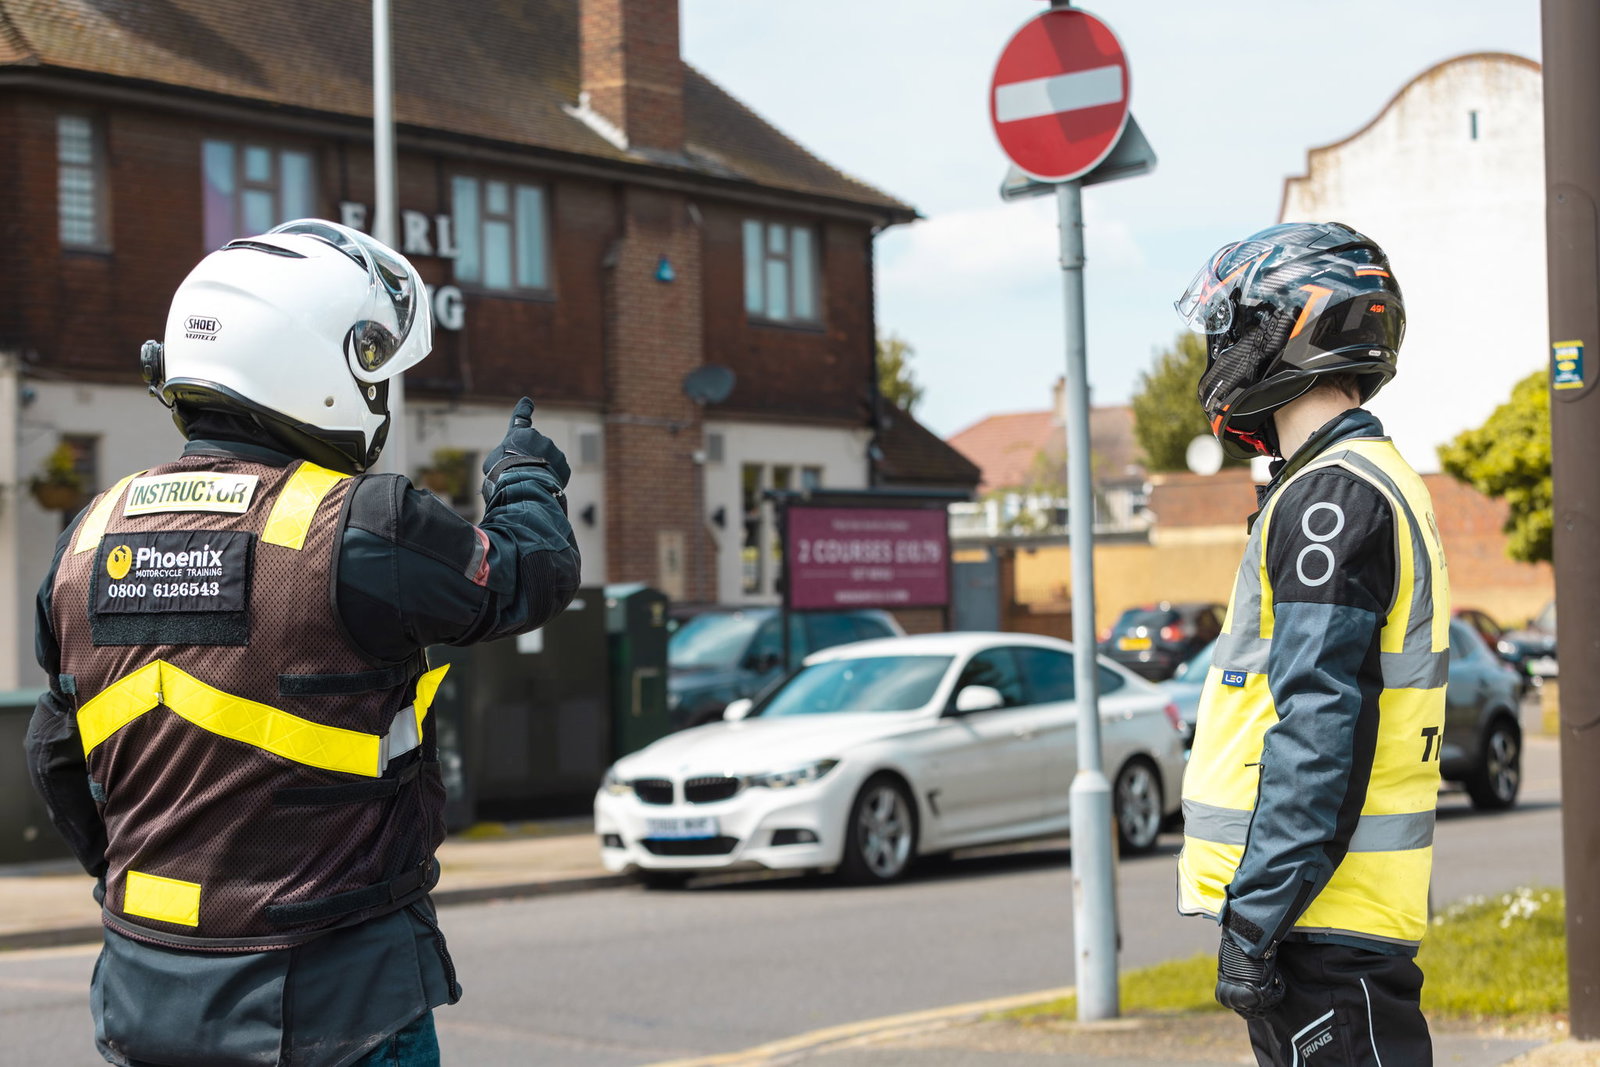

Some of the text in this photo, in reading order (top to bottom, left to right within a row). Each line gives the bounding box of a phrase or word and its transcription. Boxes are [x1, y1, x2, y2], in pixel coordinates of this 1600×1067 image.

[1370, 304, 1385, 313] 491
[188, 318, 216, 331] SHOEI
[129, 480, 248, 507] INSTRUCTOR
[135, 544, 223, 569] Phoenix
[135, 568, 222, 578] MOTORCYCLE TRAINING
[108, 582, 220, 598] 0800 6126543
[1225, 674, 1243, 683] LEO
